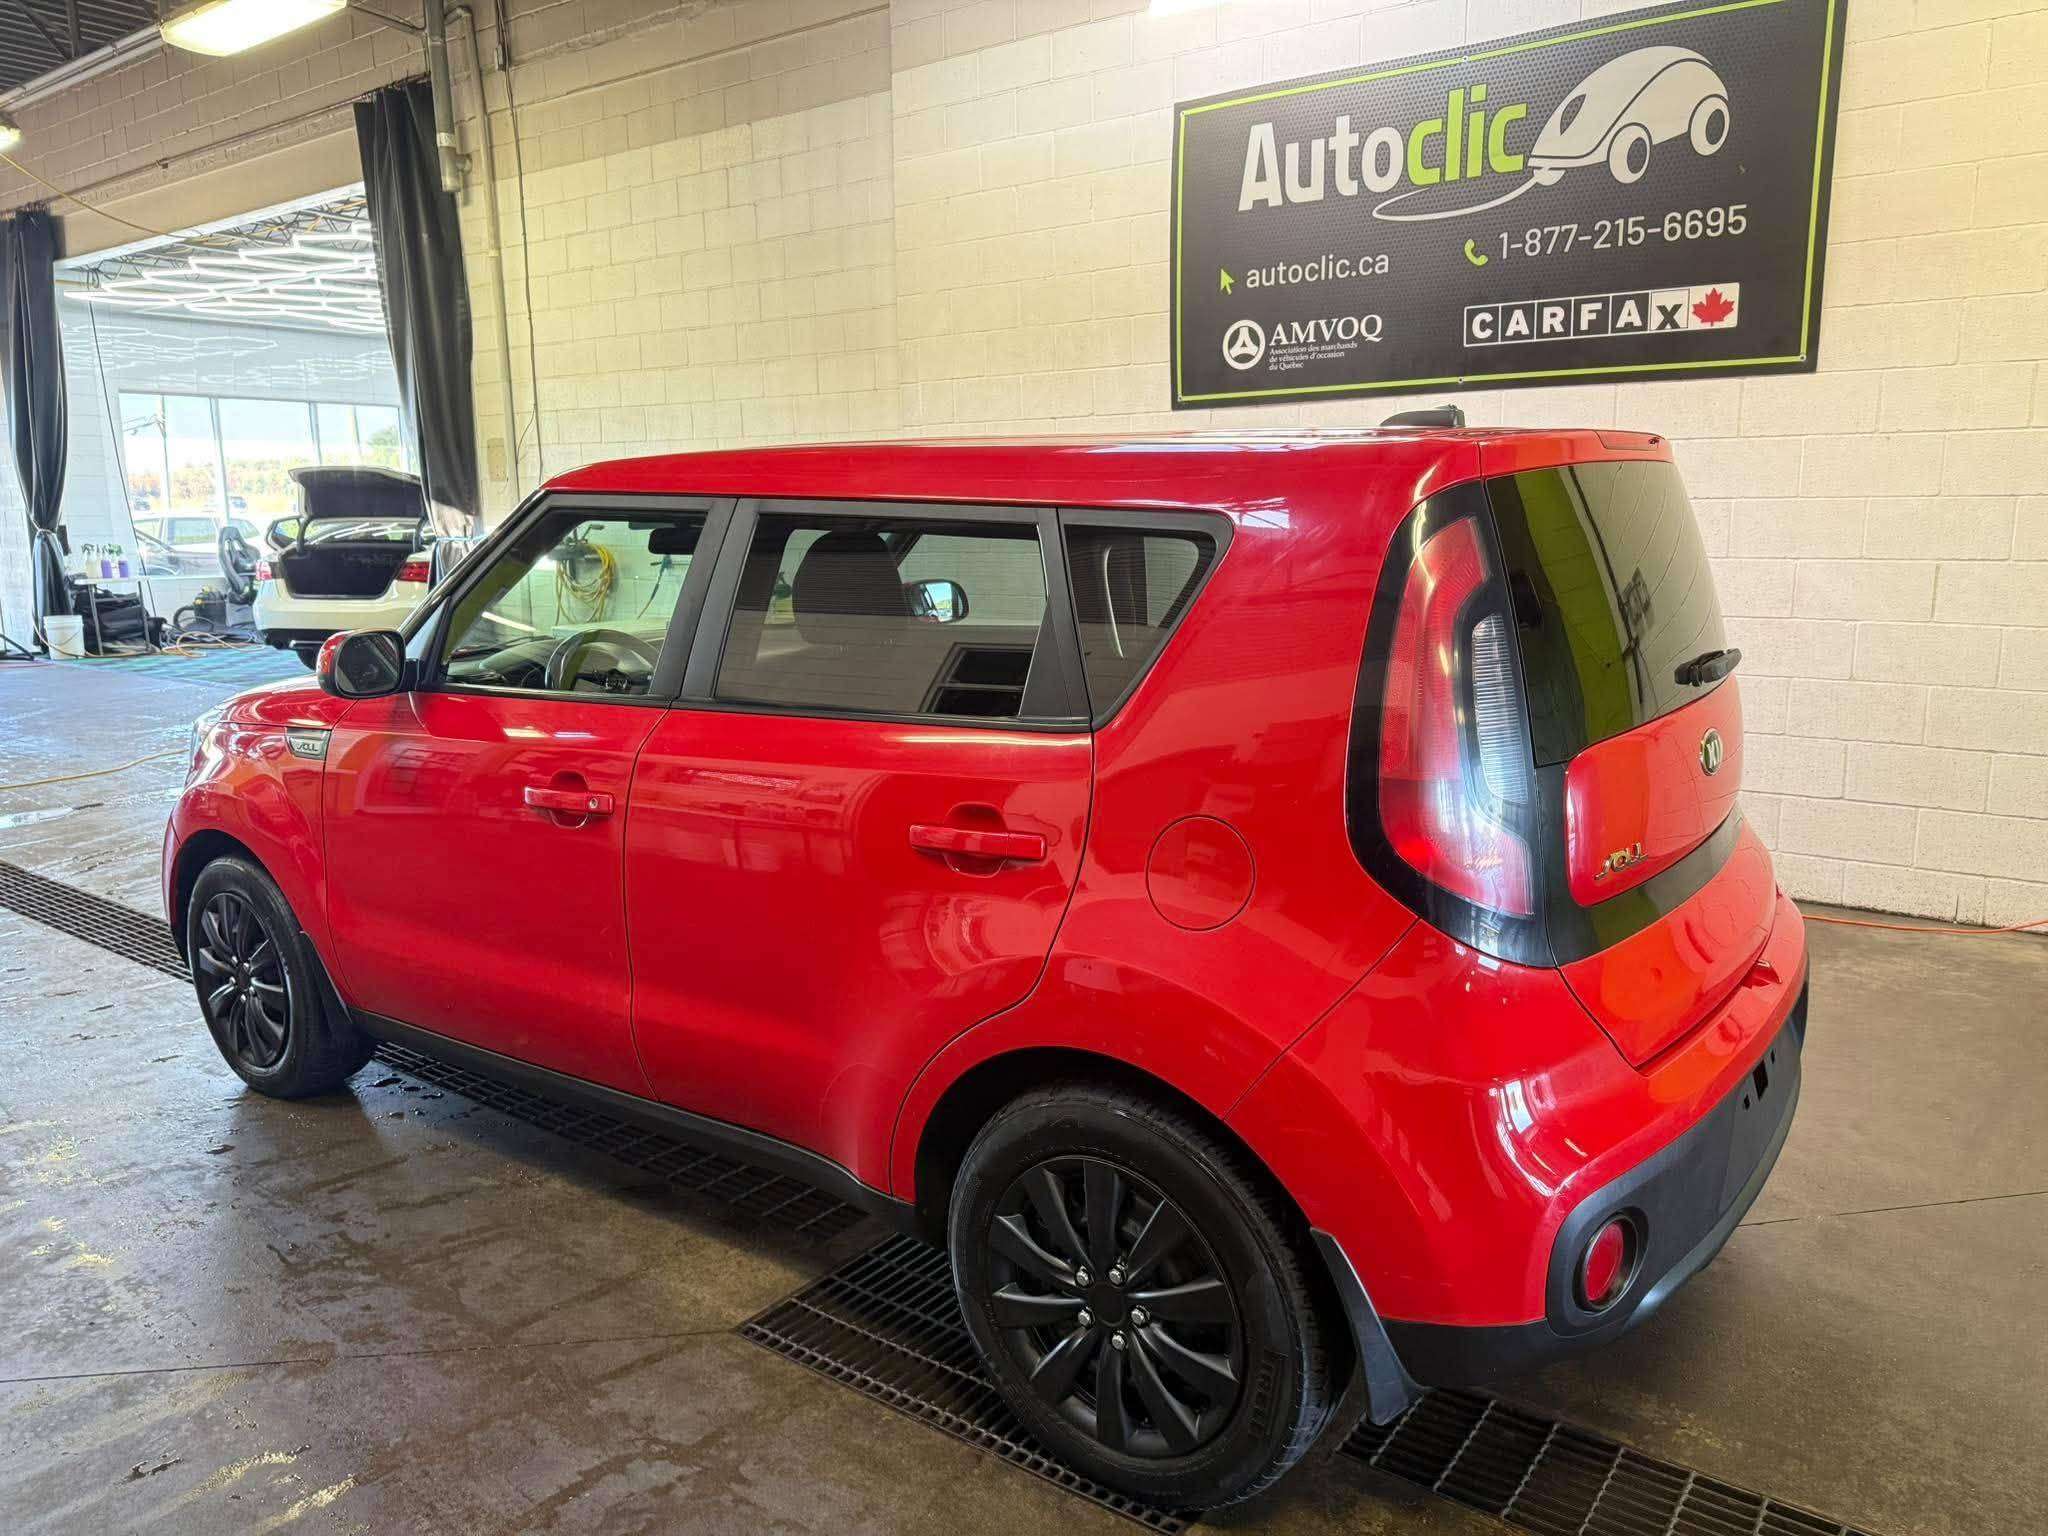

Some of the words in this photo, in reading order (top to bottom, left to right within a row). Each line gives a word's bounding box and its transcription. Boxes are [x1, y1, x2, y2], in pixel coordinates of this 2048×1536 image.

[1238, 84, 1528, 212] Autoclic
[1499, 204, 1748, 260] 1-877-215-6695
[1245, 253, 1390, 288] autoclic.ca
[1269, 314, 1383, 346] AMVOQ
[1470, 298, 1684, 339] CARFAX
[1269, 345, 1307, 355] Association
[1320, 341, 1358, 351] marchands
